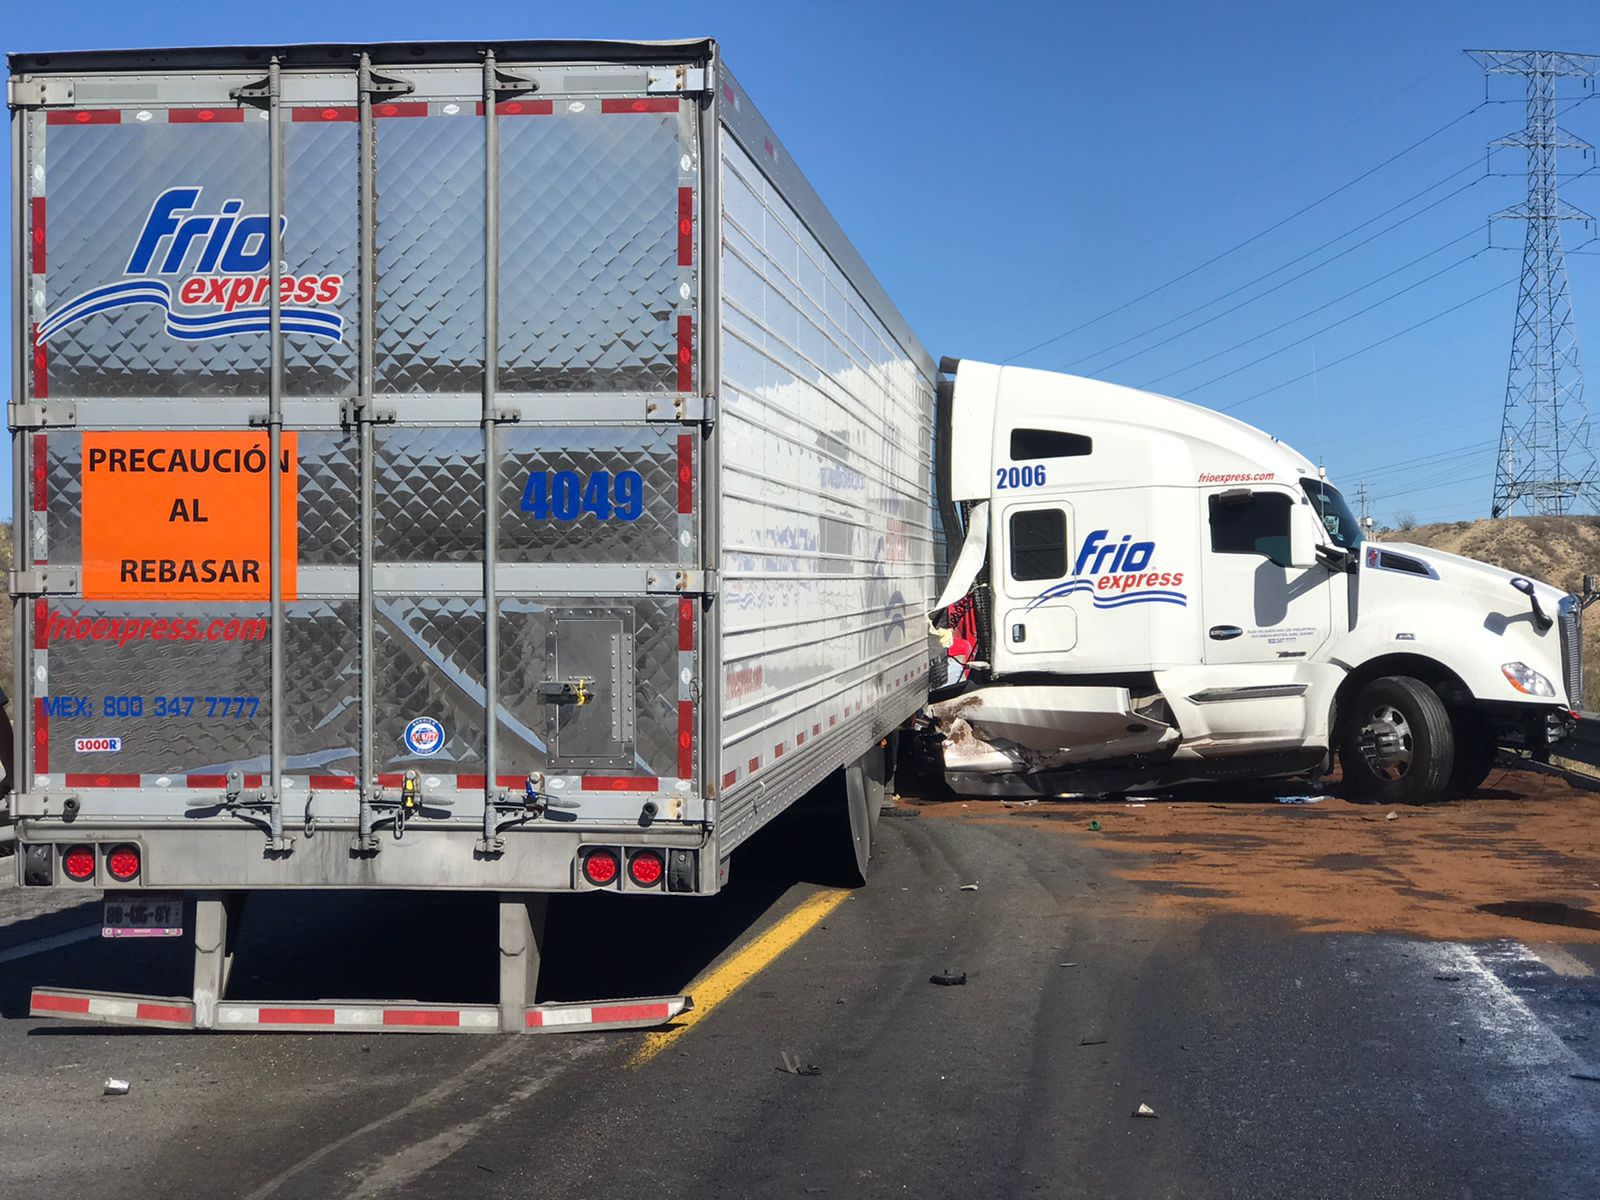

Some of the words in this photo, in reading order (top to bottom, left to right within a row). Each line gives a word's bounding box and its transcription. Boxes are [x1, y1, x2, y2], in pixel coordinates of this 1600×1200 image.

[181, 275, 342, 312] express
[996, 464, 1046, 489] 2006
[1199, 472, 1274, 483] frioexpress.com
[520, 470, 643, 521] 4049
[169, 498, 208, 522] AL
[1071, 530, 1156, 575] frio
[120, 560, 260, 583] REBASAR
[1097, 572, 1184, 592] express
[43, 610, 267, 648] frioexpress.com
[42, 696, 92, 717] MEX:
[103, 696, 142, 717] 800
[154, 696, 195, 717] 347
[204, 696, 260, 719] 7777
[77, 739, 117, 750] 3000R
